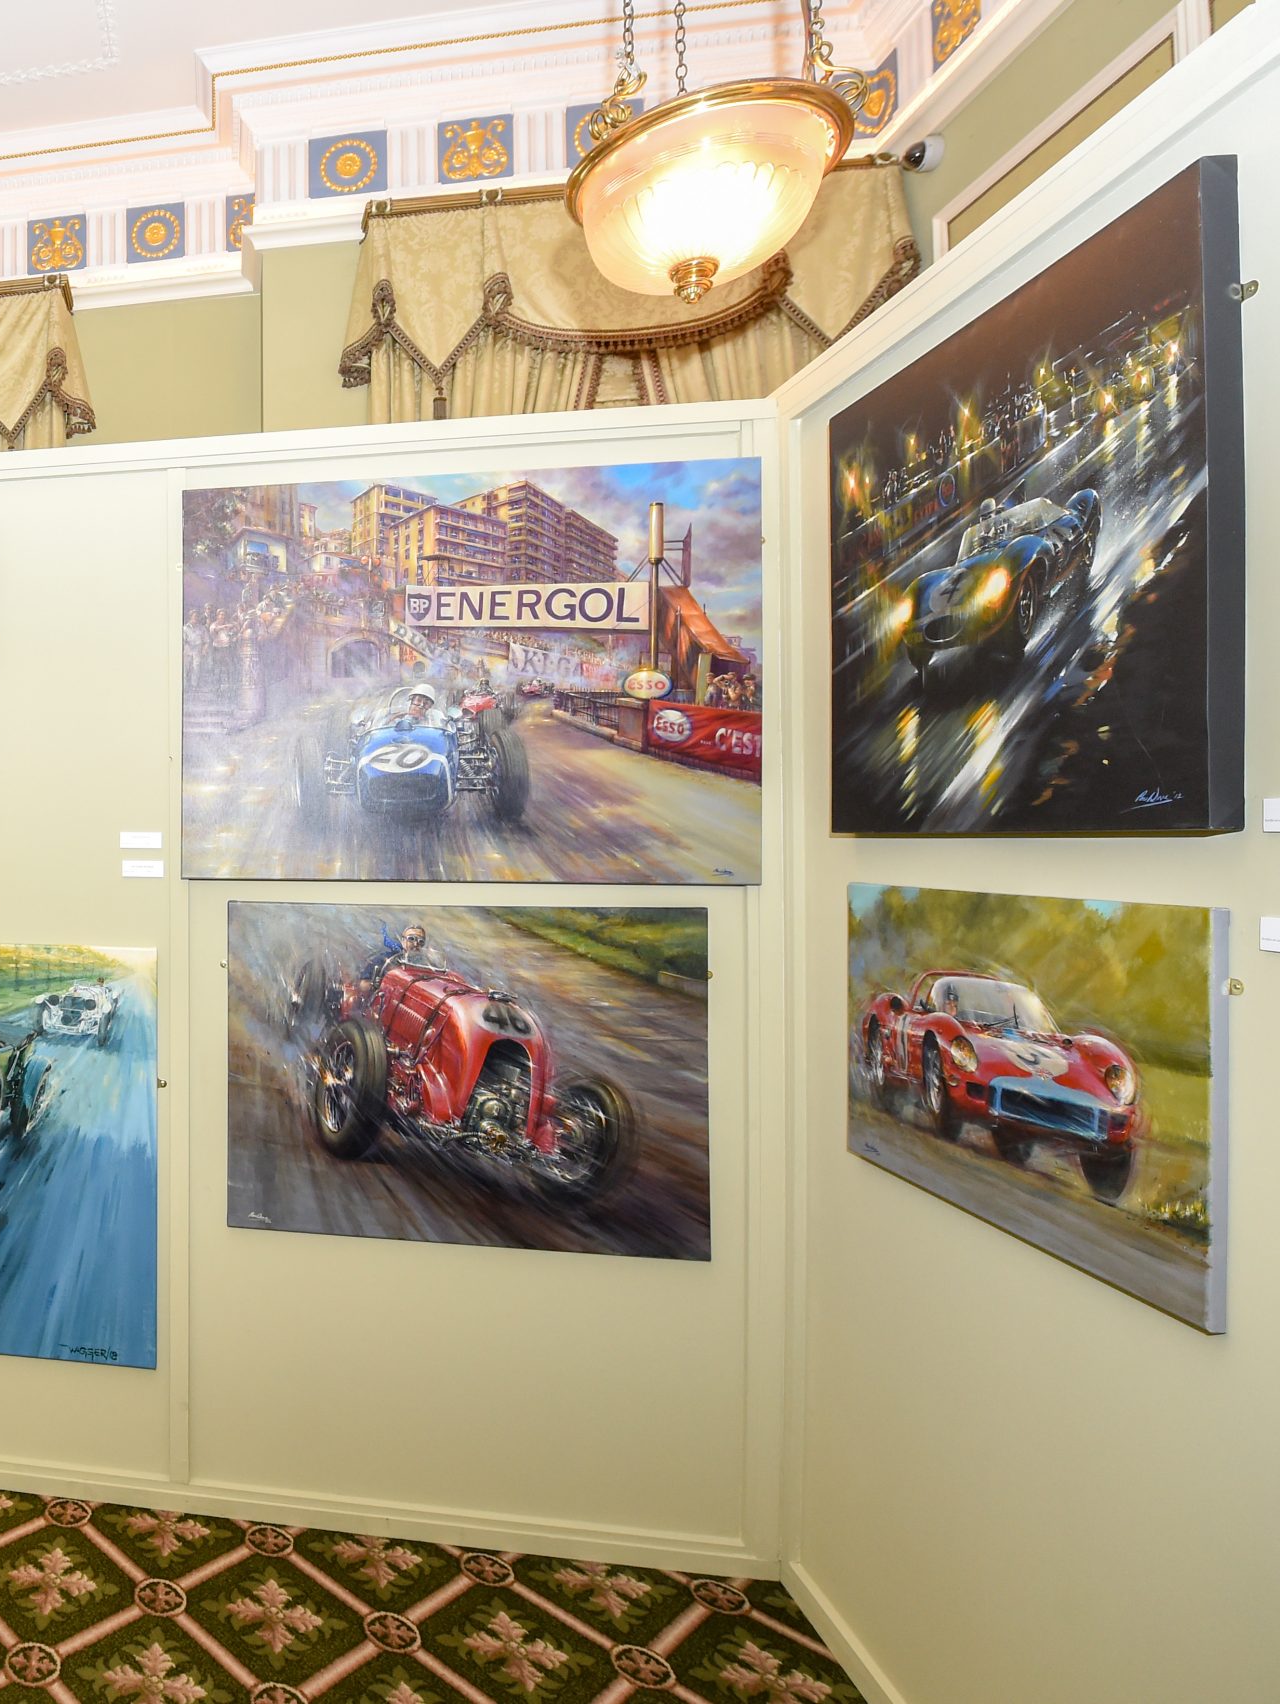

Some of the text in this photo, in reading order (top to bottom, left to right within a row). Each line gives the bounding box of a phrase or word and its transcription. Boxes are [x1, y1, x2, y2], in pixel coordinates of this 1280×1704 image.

[408, 587, 640, 623] BP ENERGOL
[627, 679, 666, 691] ESSO
[369, 745, 429, 769] 20
